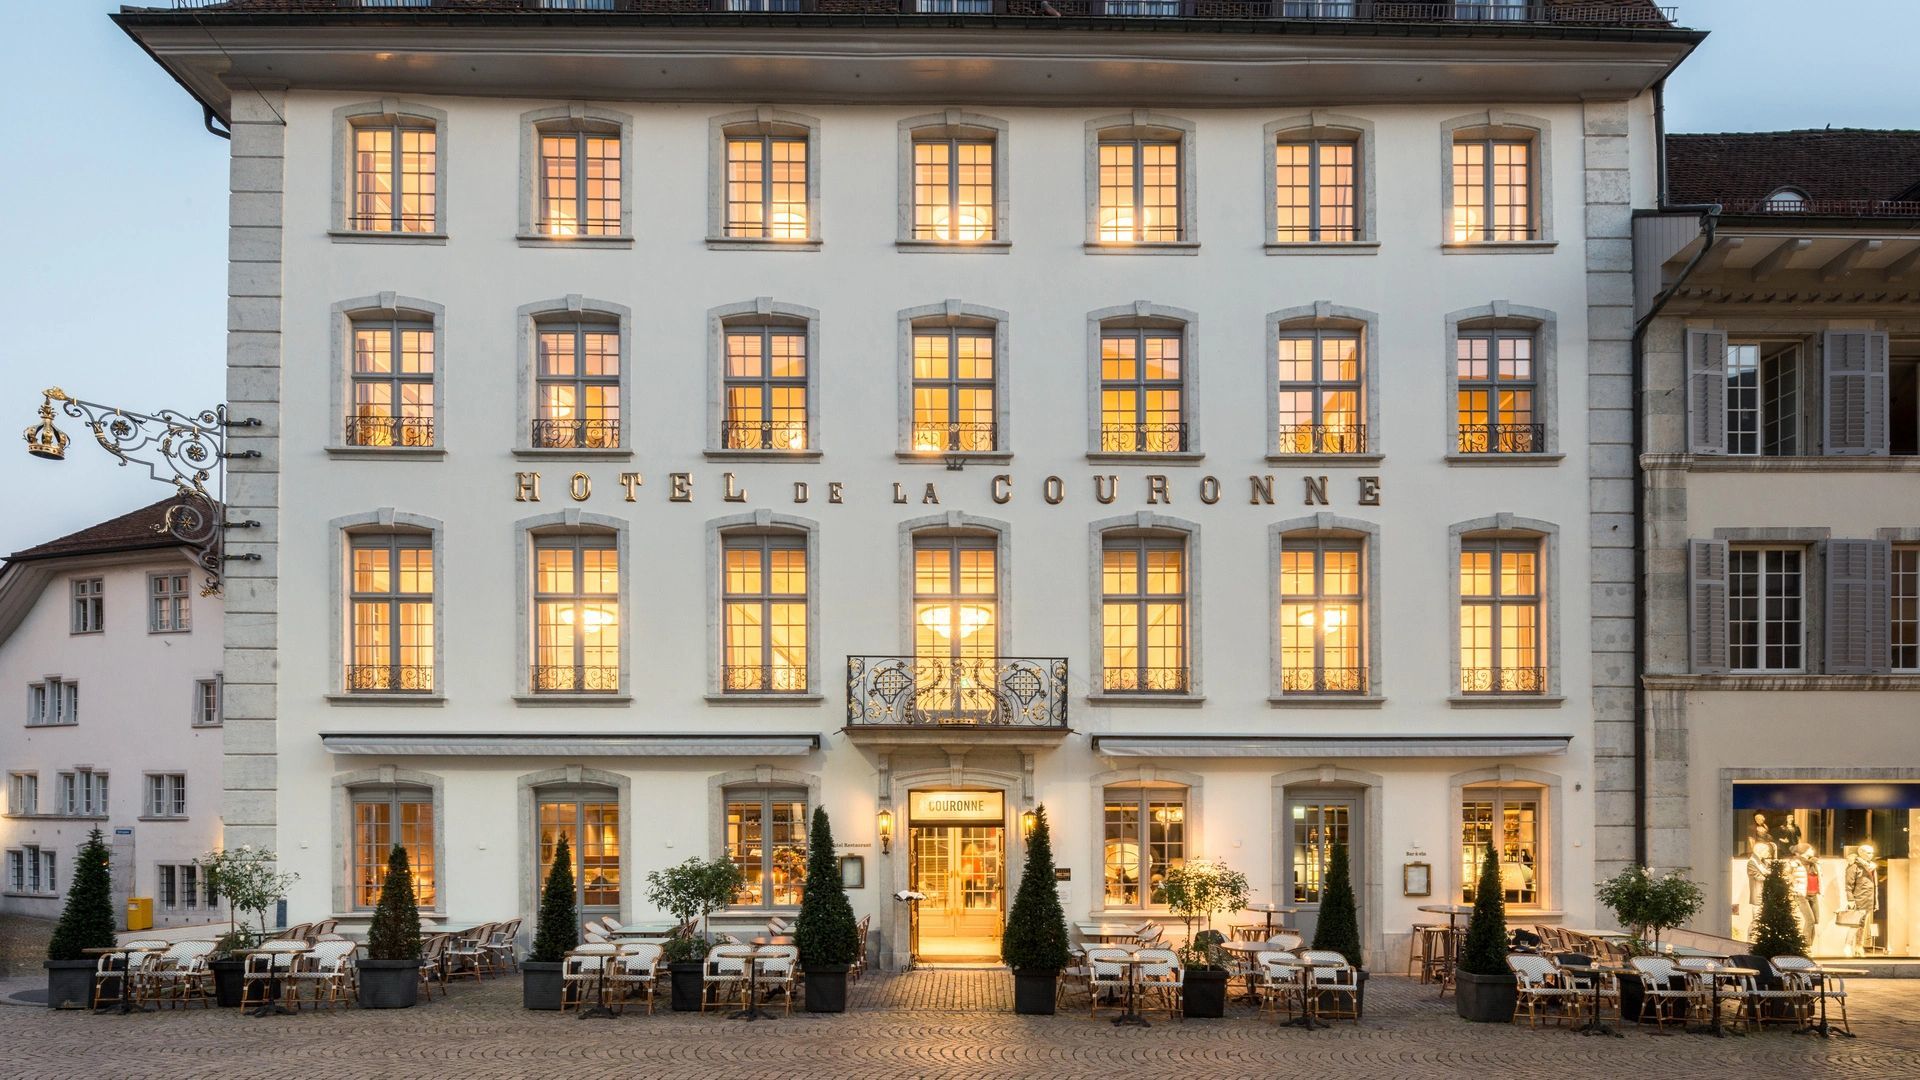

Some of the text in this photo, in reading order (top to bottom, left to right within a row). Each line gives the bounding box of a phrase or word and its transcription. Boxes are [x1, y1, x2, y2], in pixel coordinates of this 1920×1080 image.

[515, 471, 1381, 506] HOTEL DE LA COURONNE
[929, 800, 984, 811] COURONNE
